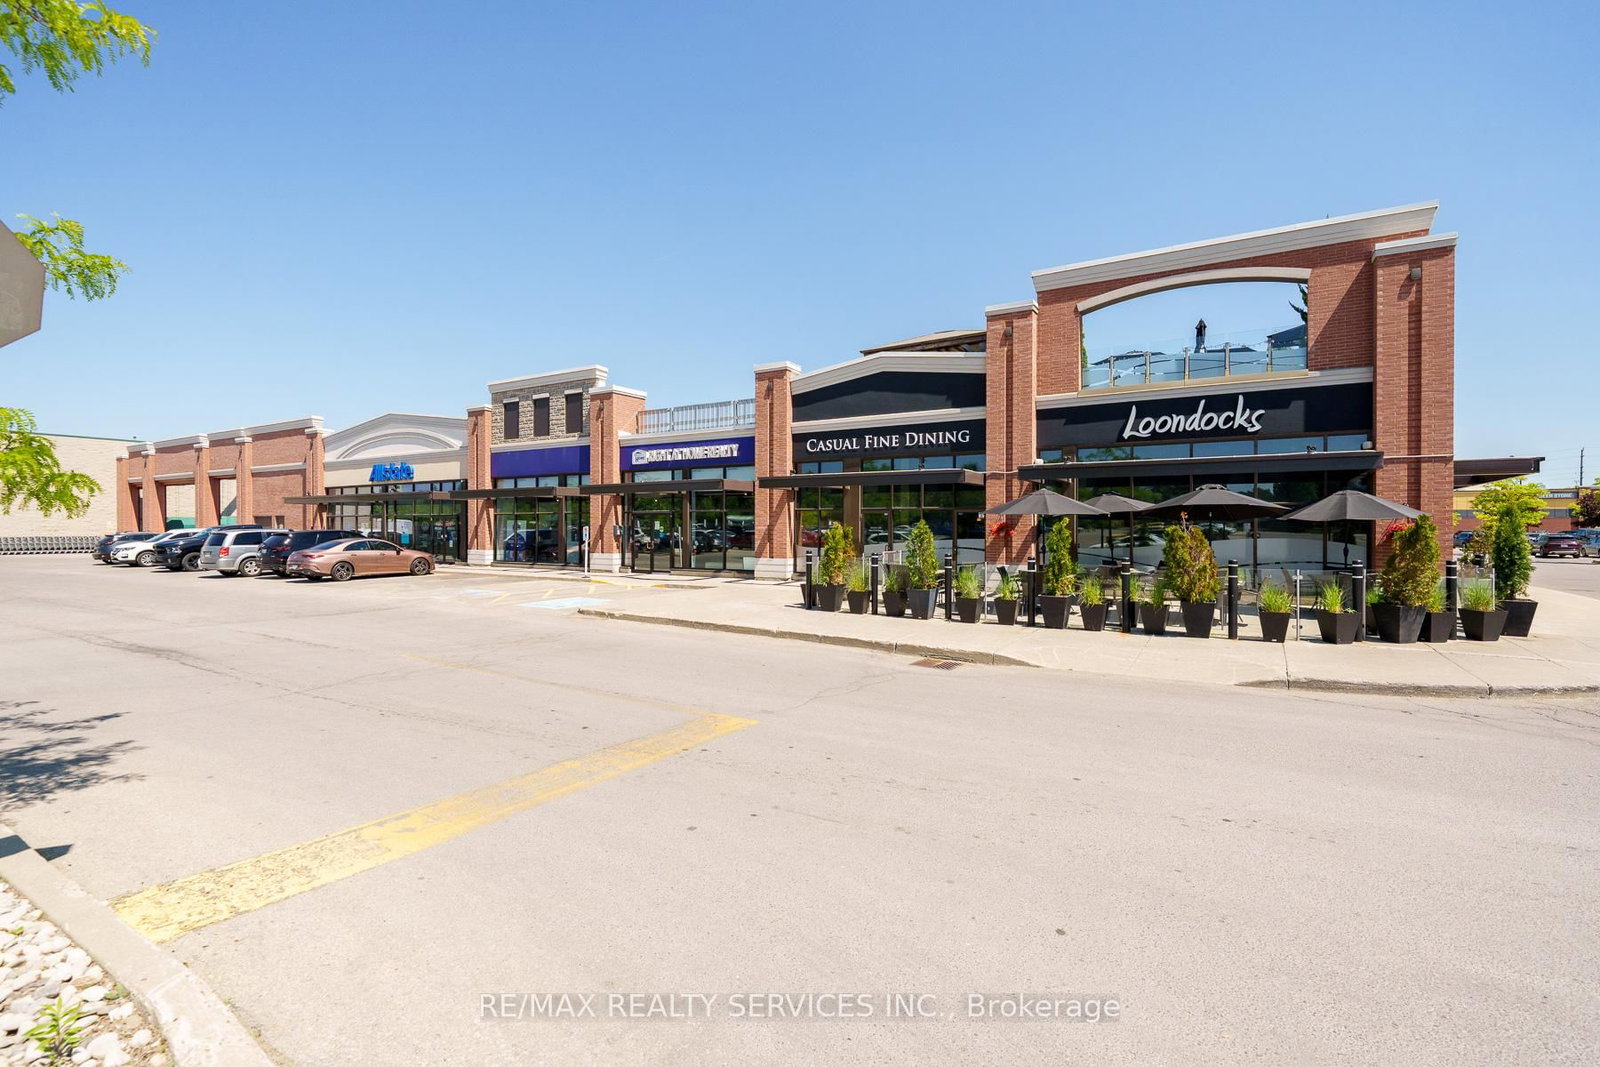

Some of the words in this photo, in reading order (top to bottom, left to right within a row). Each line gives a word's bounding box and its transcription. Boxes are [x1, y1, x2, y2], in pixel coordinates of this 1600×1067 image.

[1122, 394, 1266, 440] Loondocks
[806, 438, 860, 452] CASUAL
[864, 434, 900, 449] FINE
[905, 429, 970, 446] DINING
[369, 461, 414, 482] Allstate
